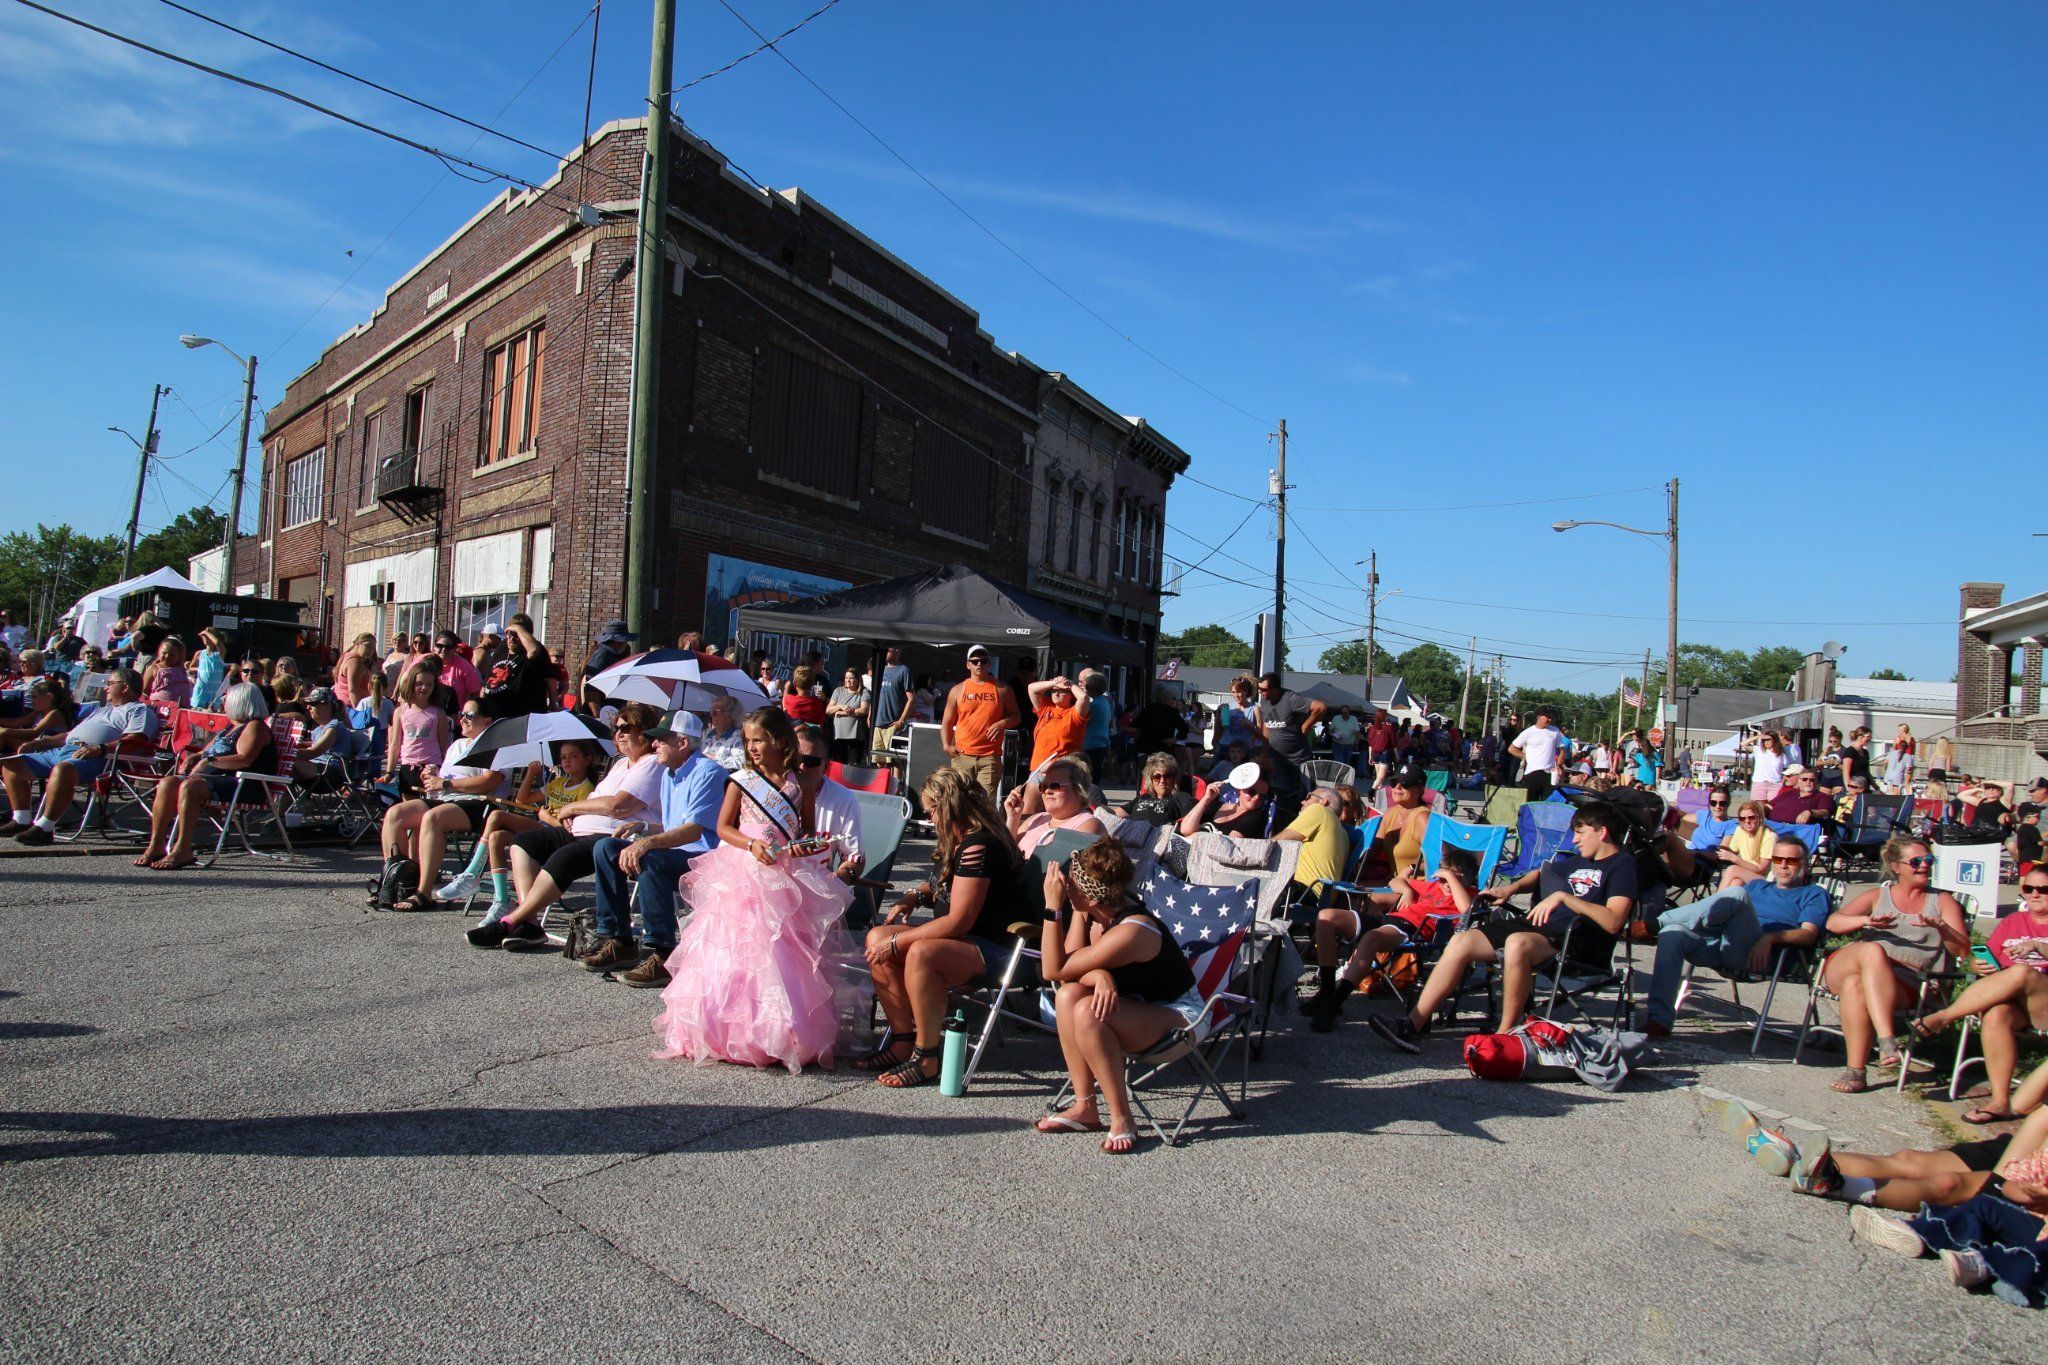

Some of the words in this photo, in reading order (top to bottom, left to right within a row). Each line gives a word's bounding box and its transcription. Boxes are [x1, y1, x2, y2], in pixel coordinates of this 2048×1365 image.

[1006, 627, 1031, 635] COBIZI
[1166, 661, 1177, 680] CO
[962, 692, 995, 703] JONES
